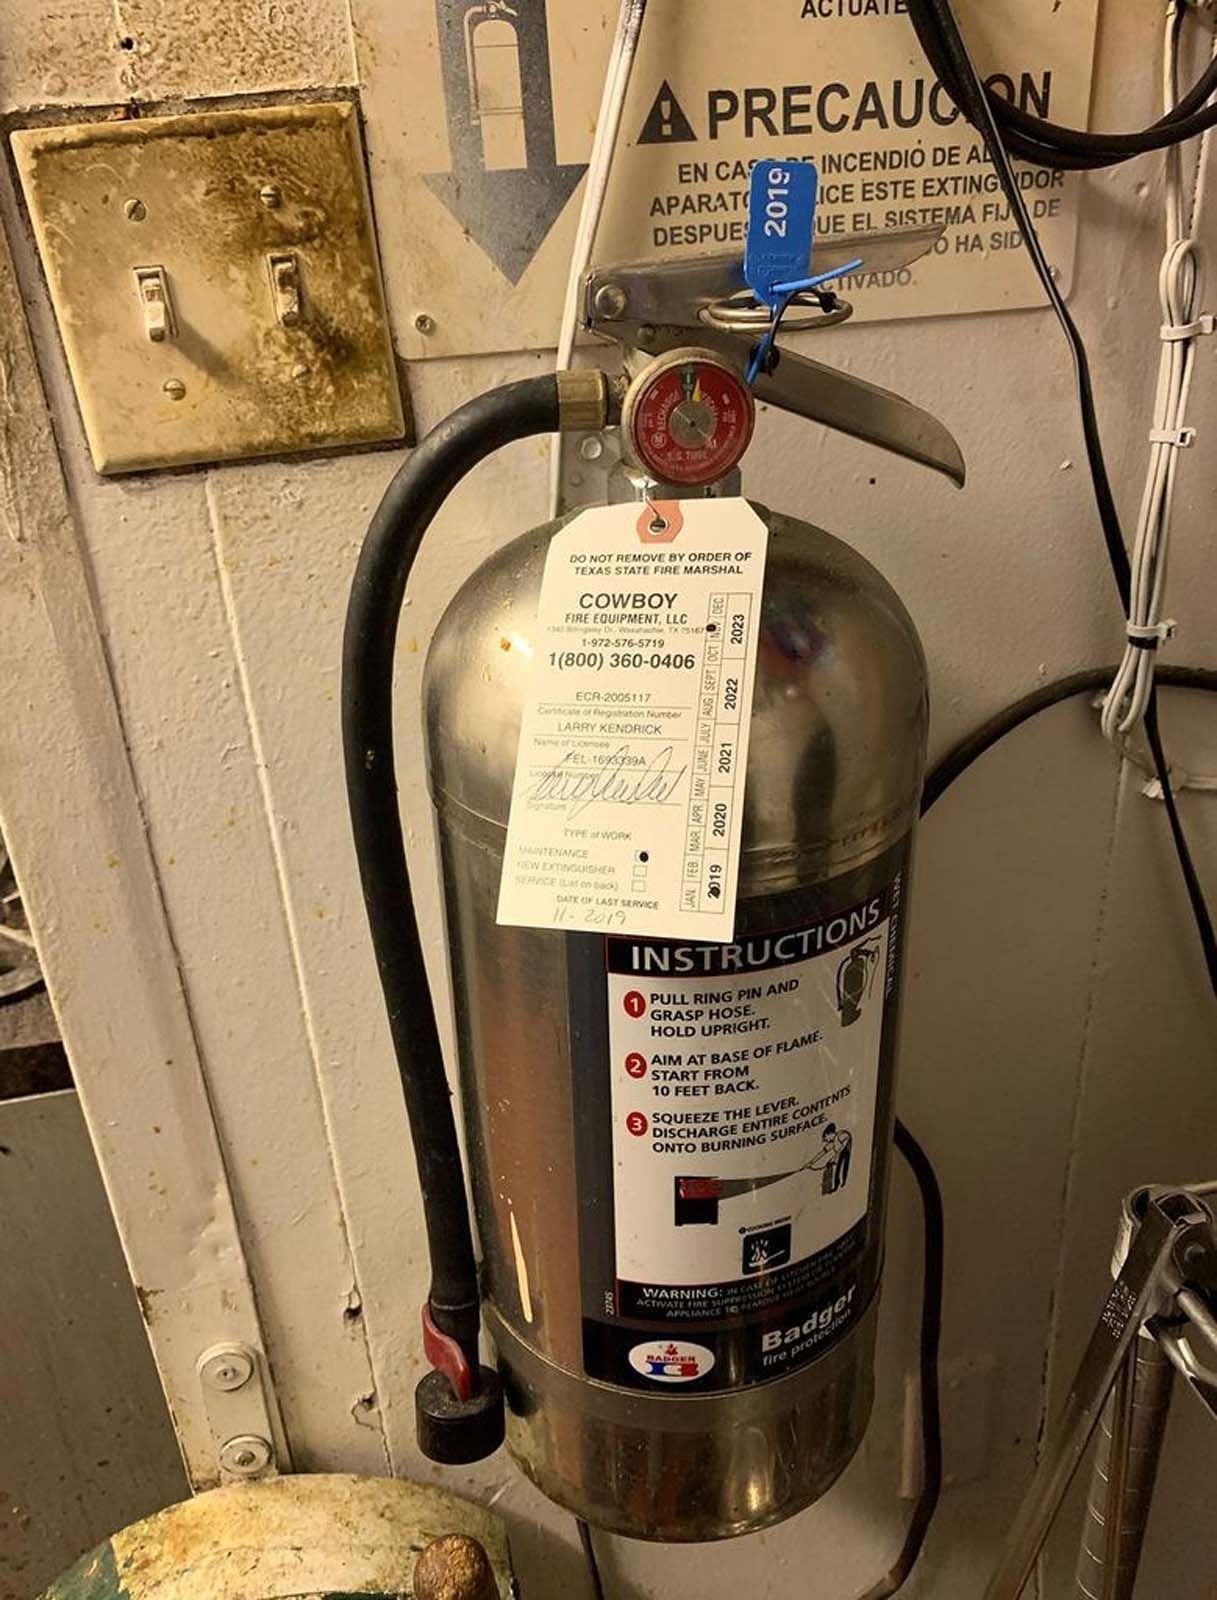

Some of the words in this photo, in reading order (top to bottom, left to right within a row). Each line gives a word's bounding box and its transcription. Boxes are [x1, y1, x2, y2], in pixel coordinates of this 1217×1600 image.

[707, 71, 1052, 140] PRECAUCON
[678, 162, 708, 184] EN
[932, 146, 961, 167] DE
[861, 180, 916, 201] ESTE
[922, 170, 1065, 197] EXTINGDOR
[763, 167, 791, 238] 2019
[654, 222, 750, 247] DESPUE
[812, 214, 846, 237] UE
[852, 212, 878, 232] EL
[885, 204, 976, 228] SISTEMA
[982, 202, 1010, 222] FIJ
[1033, 197, 1062, 218] DE
[955, 233, 984, 255] HA
[989, 229, 1024, 252] SID
[569, 552, 588, 564] DO
[589, 552, 614, 564] NOT
[615, 552, 666, 564] REMOVE
[668, 552, 687, 563] BY
[688, 551, 733, 563] ORDER
[734, 551, 754, 563] OF
[574, 565, 612, 576] TEXAS
[614, 565, 651, 576] STATE
[653, 565, 681, 576] FIRE
[682, 564, 744, 576] MARSHAL
[578, 592, 679, 610] COWBOY
[711, 597, 724, 616] DEC
[564, 613, 590, 625] FIRE
[592, 612, 663, 627] EQUIPMENT,
[666, 613, 689, 626] LLC
[729, 613, 746, 645] 2023
[581, 638, 666, 649] 1-972-576-5719
[706, 641, 720, 663] OCT
[548, 652, 605, 671] 1(800)
[609, 653, 696, 670] 360-0406
[703, 669, 717, 692] SEPT
[575, 691, 652, 703] ECR-2005117
[723, 677, 739, 711] 2022
[536, 706, 581, 716] Certificate
[582, 707, 592, 716] of
[593, 708, 645, 719] Registration
[646, 710, 682, 720] Number
[701, 696, 714, 717] AUG
[557, 721, 597, 734] LARRY
[599, 723, 663, 735] KENDRICK
[699, 722, 712, 744] JULY
[696, 749, 710, 773] JUNE
[717, 742, 733, 774] 2021
[694, 777, 706, 798] MAY
[712, 802, 728, 838] 2020
[564, 827, 589, 839] TYPE
[599, 831, 633, 841] WORK
[518, 846, 589, 859] MAINTENANCE
[516, 860, 540, 871] NEW
[541, 862, 616, 875] EXTINGUISHER
[686, 860, 700, 879] FEB
[514, 875, 558, 888] SERVICE
[556, 894, 580, 904] DATE
[581, 896, 593, 905] OF
[595, 897, 618, 907] LAST
[620, 899, 660, 910] SERVICE
[684, 888, 697, 908] JAN
[583, 908, 627, 926] 2019
[631, 898, 881, 971] INSTRUCTIONS
[650, 992, 690, 1006] PULL
[693, 991, 733, 1006] RING
[738, 986, 763, 1002] PIN
[766, 978, 800, 998] AND
[650, 1008, 703, 1022] GRASP
[709, 1005, 756, 1021] HOSE.
[650, 1024, 697, 1038] HOLD
[700, 1017, 771, 1038] UPRIGHT.
[650, 1053, 683, 1067] AIM
[686, 1053, 707, 1067] AT
[711, 1049, 749, 1066] BASE
[753, 1046, 773, 1060] OF
[775, 1029, 824, 1055] FLAME.
[651, 1068, 701, 1082] START
[704, 1065, 750, 1081] FROM
[652, 1085, 670, 1097] 10
[674, 1083, 711, 1098] FEET
[715, 1078, 760, 1096] BACK.
[652, 1111, 720, 1125] SQUEEZE
[723, 1107, 752, 1122] THE
[755, 1096, 800, 1118] LEVER.
[652, 1123, 738, 1140] DISCHARGE
[742, 1113, 789, 1135] ENTIRE
[791, 1084, 852, 1121] CONTENTS
[652, 1140, 697, 1154] ONTO
[700, 1133, 767, 1152] BURNING
[769, 1113, 829, 1143] SURFACE.
[636, 1298, 691, 1309] ACTIVATE
[641, 1286, 724, 1300] WARNING:
[761, 1284, 856, 1352] Badger
[762, 1350, 788, 1367] fire
[790, 1308, 852, 1359] protection
